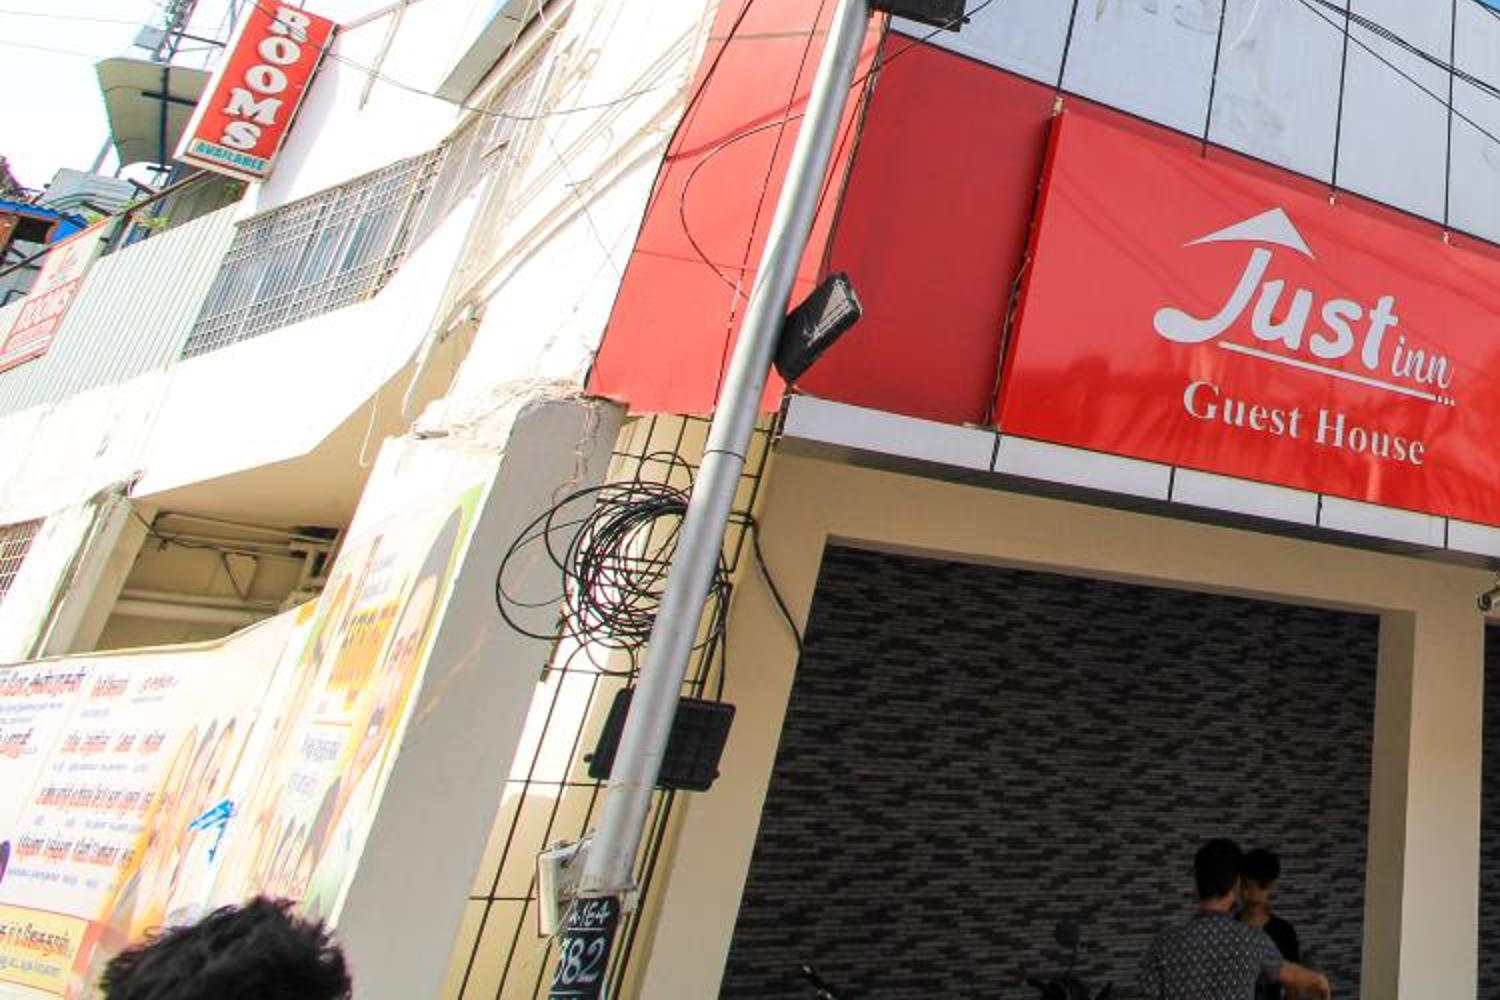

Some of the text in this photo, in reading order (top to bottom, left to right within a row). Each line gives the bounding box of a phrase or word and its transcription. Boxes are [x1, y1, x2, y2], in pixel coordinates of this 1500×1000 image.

[219, 6, 311, 150] ROOMS
[1153, 248, 1452, 389] Just inn
[1183, 380, 1425, 465] Guest House
